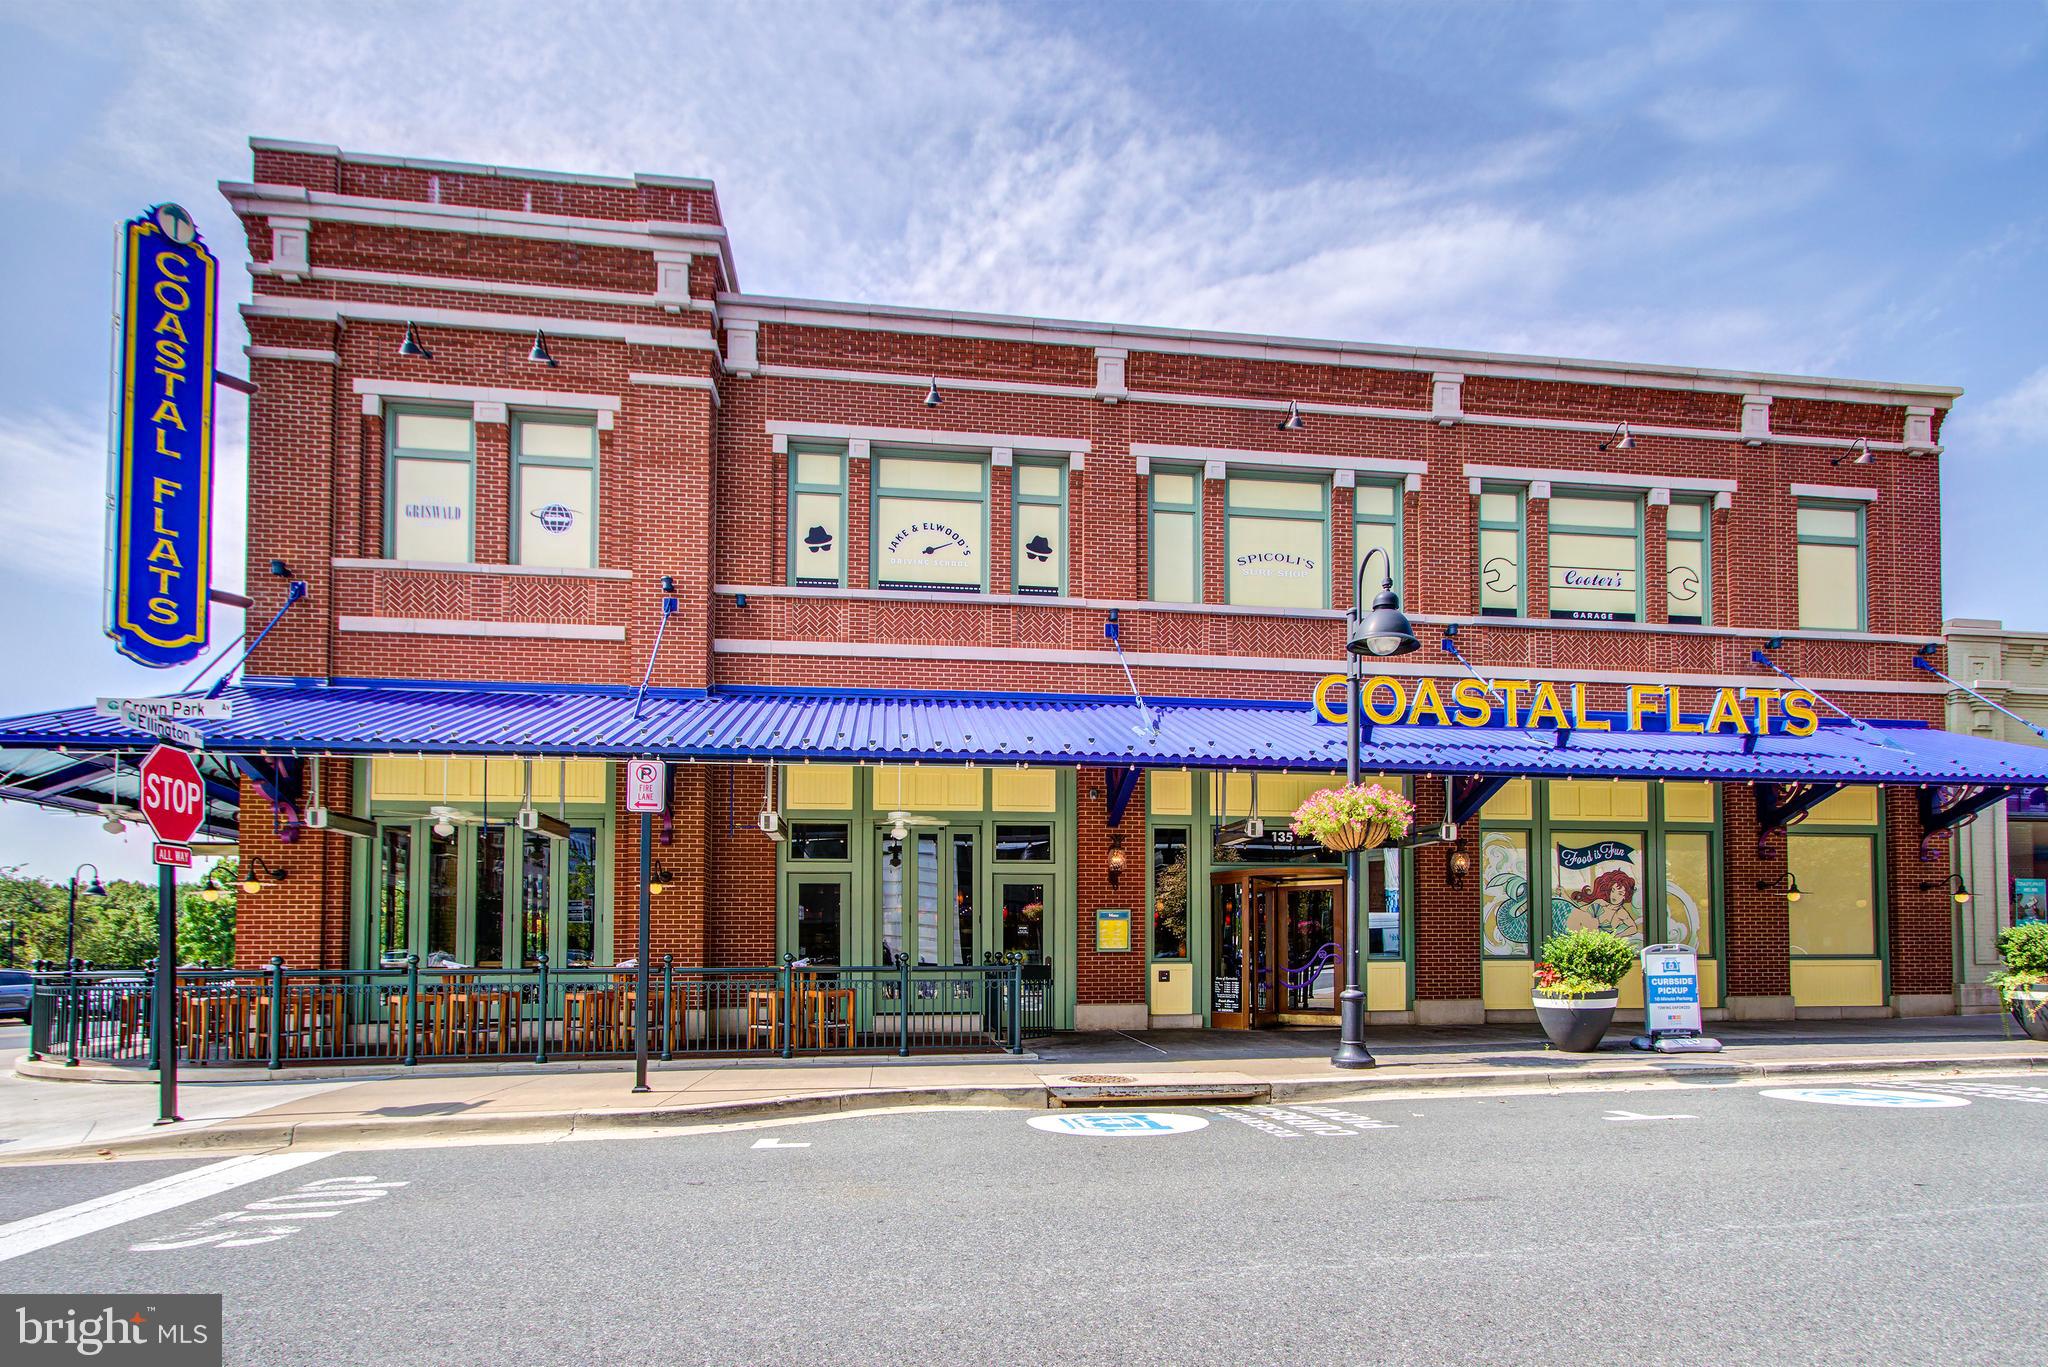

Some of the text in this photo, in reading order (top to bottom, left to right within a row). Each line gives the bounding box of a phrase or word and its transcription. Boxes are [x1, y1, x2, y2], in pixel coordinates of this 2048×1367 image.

[147, 251, 191, 625] COASTAL FLATS
[404, 504, 461, 520] GRISWALD
[888, 522, 971, 556] JAKE & ELWOOD'S
[933, 559, 969, 568] SCHOOL
[1237, 552, 1315, 570] SPICOLI'S
[1242, 569, 1310, 578] SURF SHOP
[1565, 570, 1621, 587] Cooter's
[122, 700, 167, 718] Crown
[172, 702, 206, 717] Park
[1312, 674, 1820, 738] COASTAL FLATS
[138, 713, 191, 742] Ellington
[146, 773, 201, 815] STOP
[640, 784, 652, 792] FIRE
[1271, 831, 1294, 843] 135
[159, 848, 190, 864] ALL WAY
[1561, 842, 1625, 867] Food is Fun
